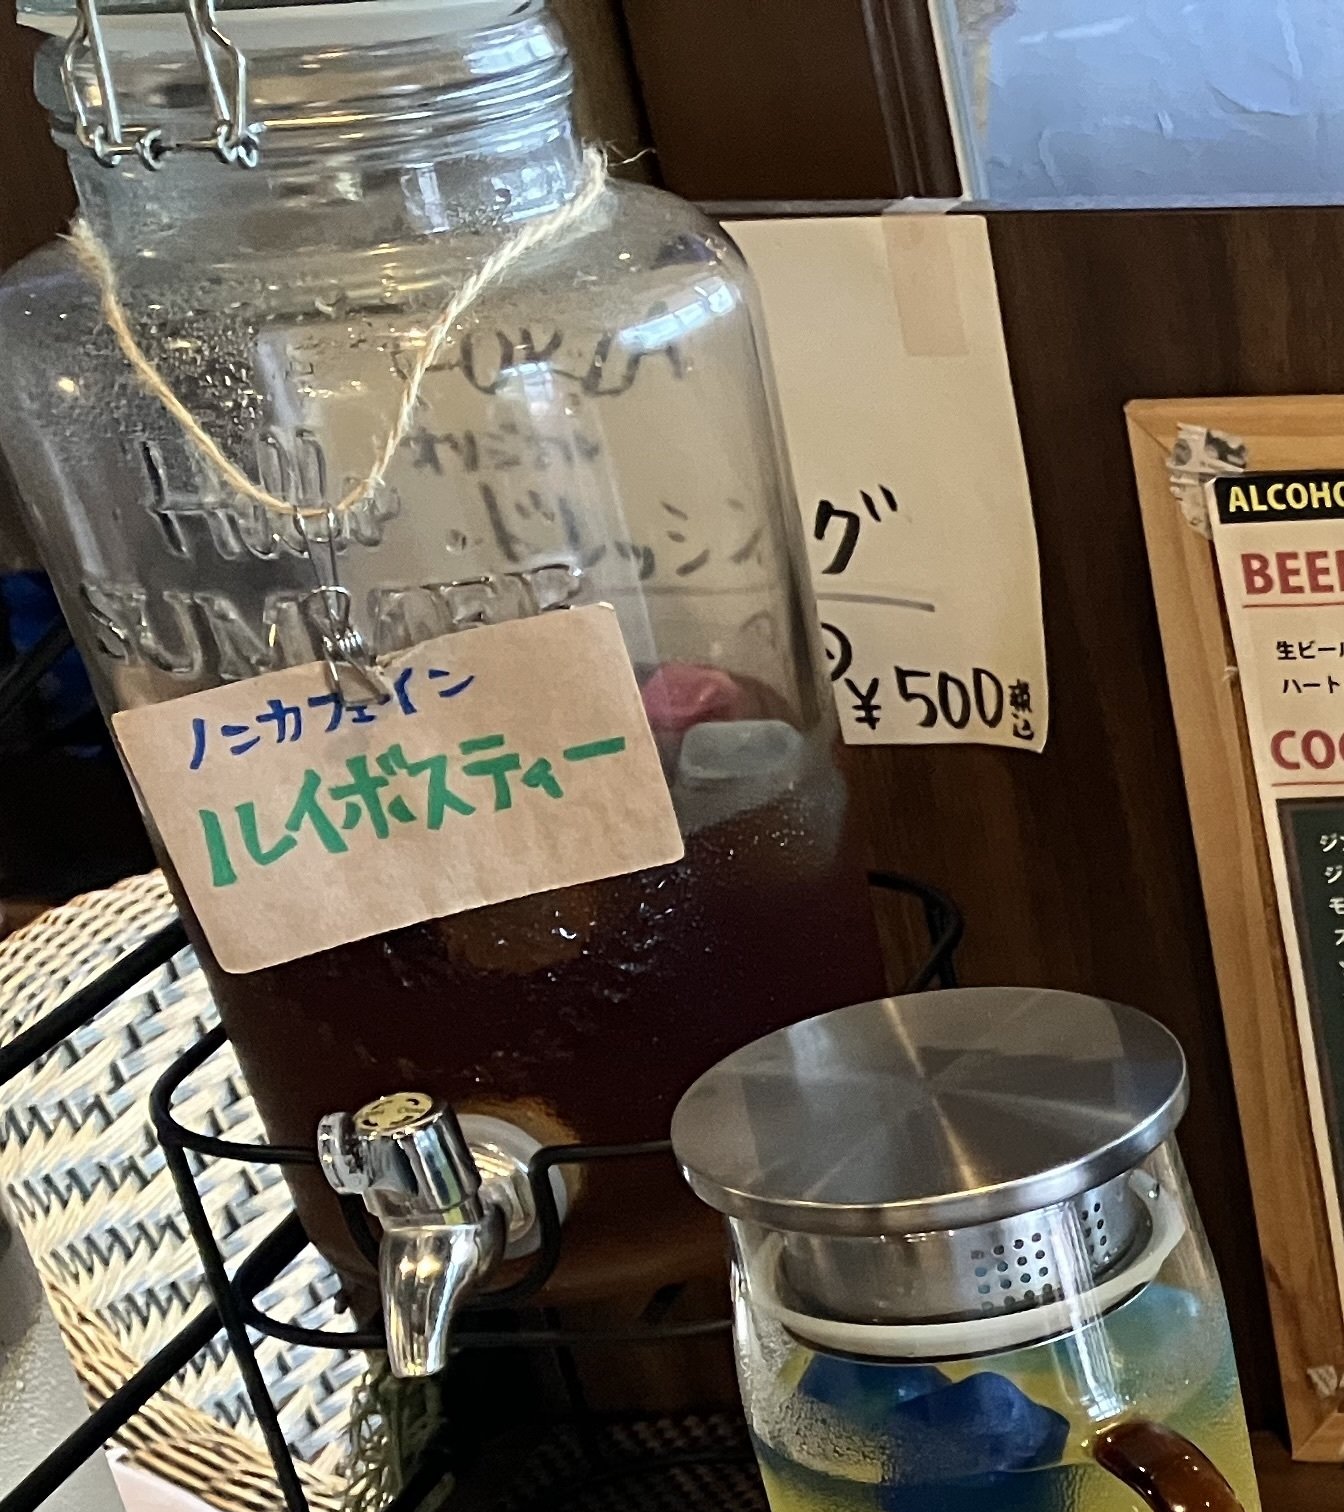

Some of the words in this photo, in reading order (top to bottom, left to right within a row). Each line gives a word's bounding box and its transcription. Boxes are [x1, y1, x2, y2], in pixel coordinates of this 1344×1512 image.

[844, 666, 1004, 731] ¥500
[198, 732, 627, 888] ルイボスティー
